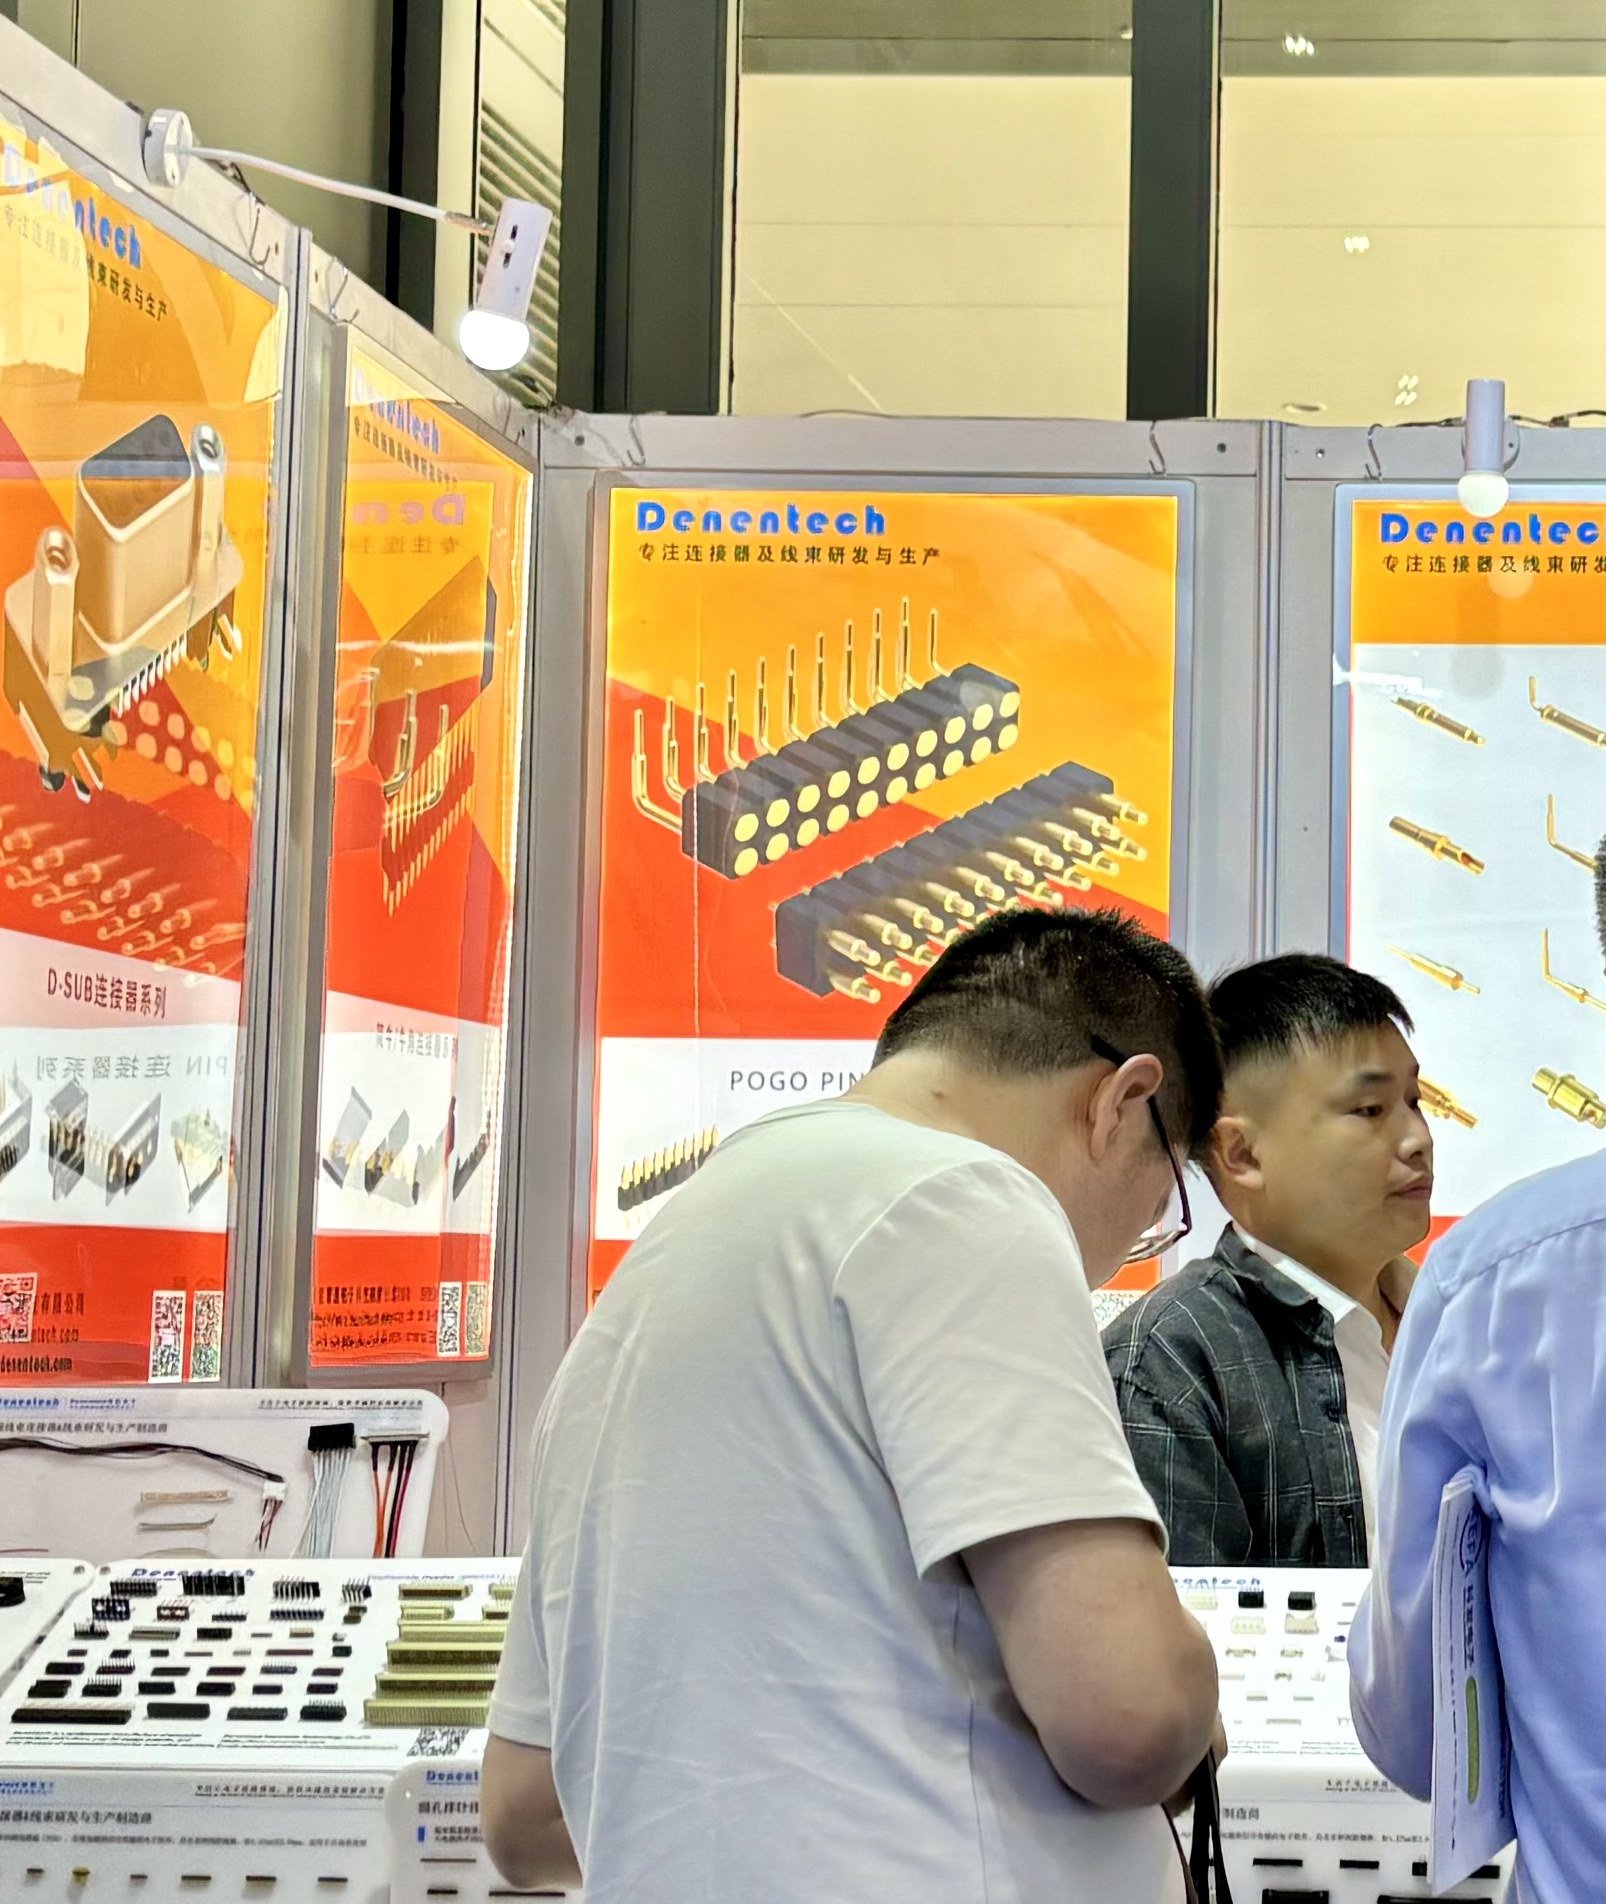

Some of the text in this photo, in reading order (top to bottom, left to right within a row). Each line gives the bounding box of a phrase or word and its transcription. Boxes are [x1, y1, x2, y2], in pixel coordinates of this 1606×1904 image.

[635, 500, 887, 537] Denentech
[637, 543, 941, 566] 专注连接器及线束研发与生产
[730, 1070, 809, 1092] POGO
